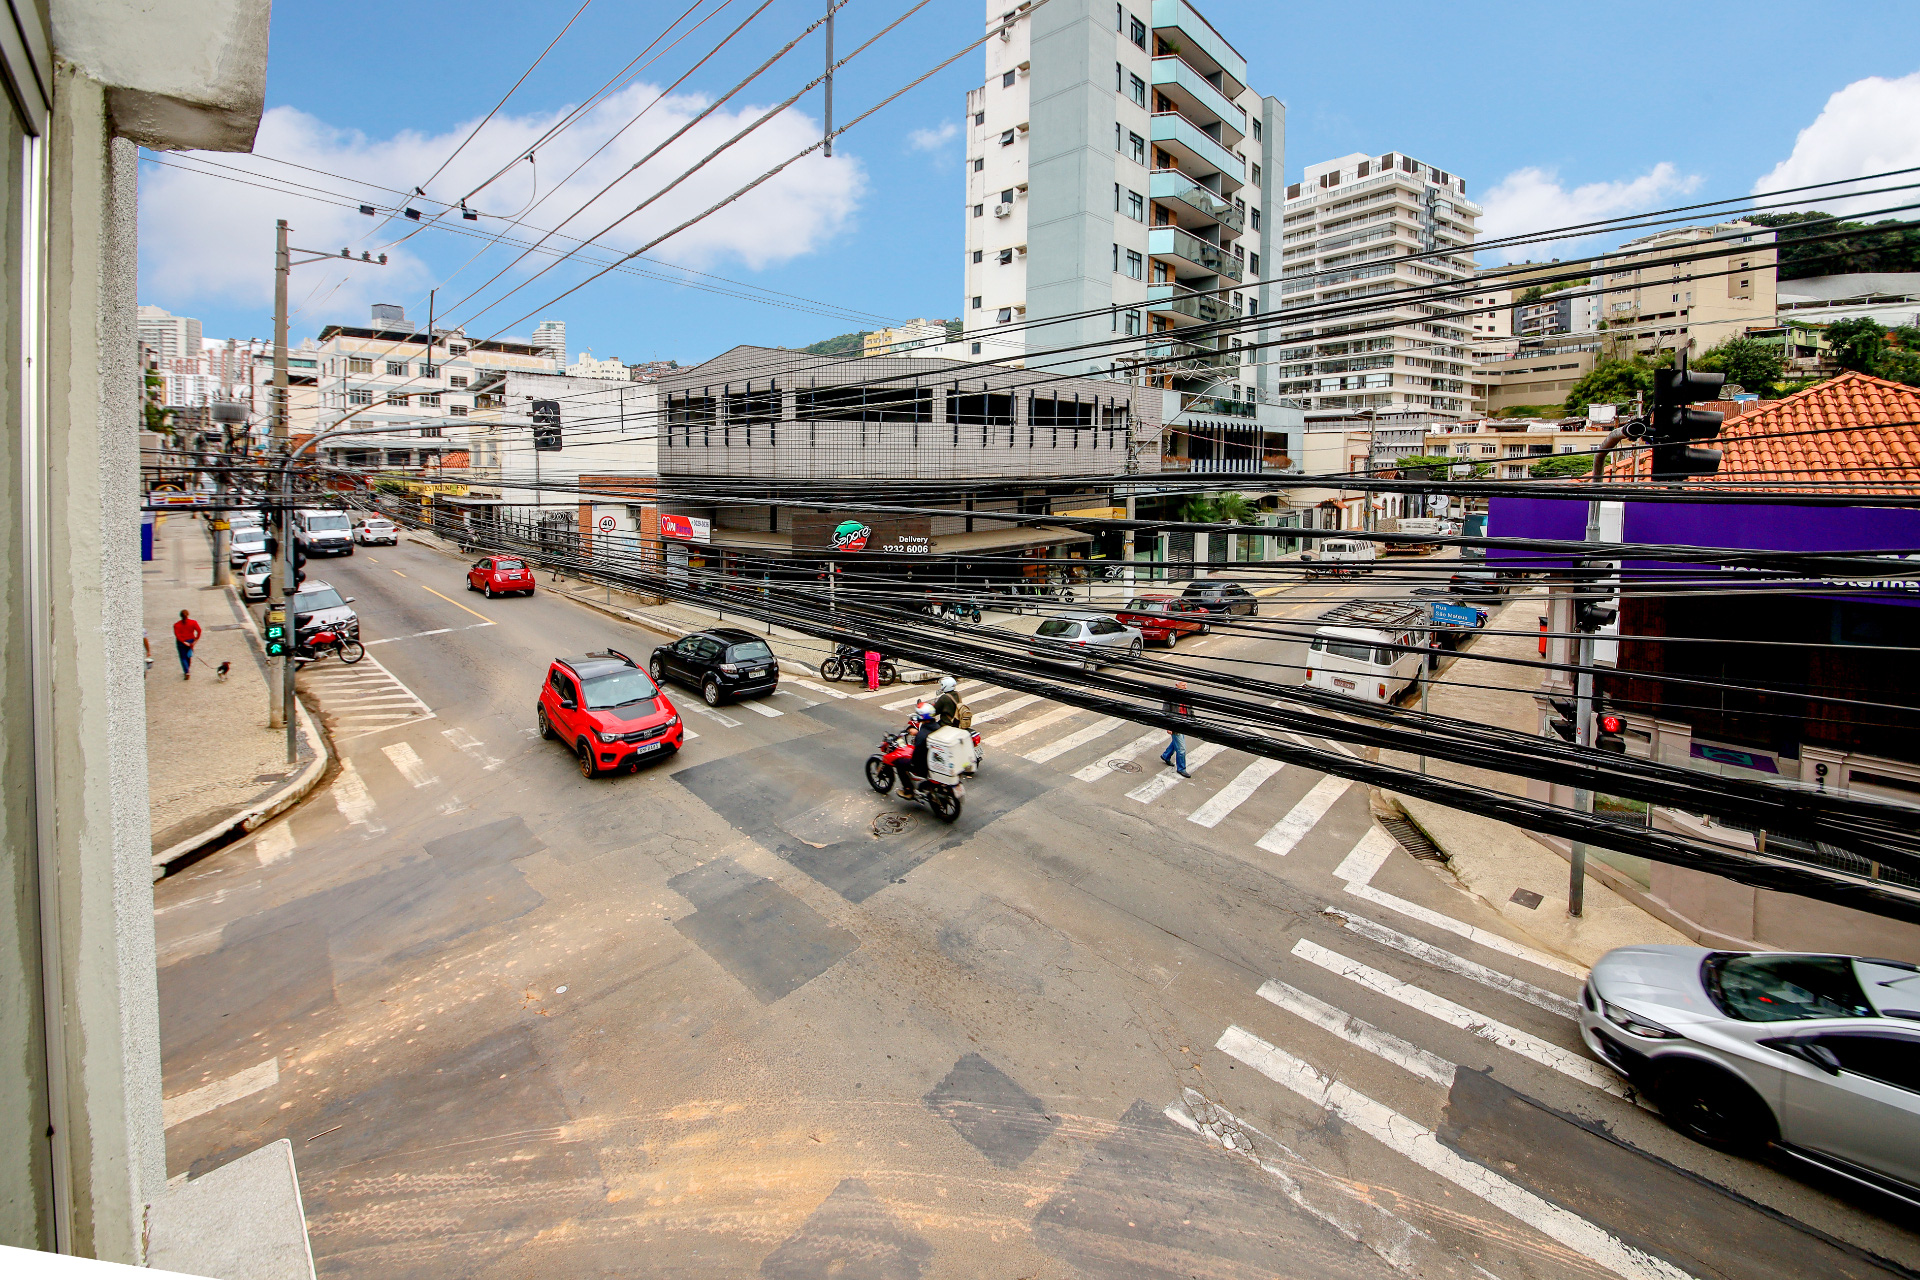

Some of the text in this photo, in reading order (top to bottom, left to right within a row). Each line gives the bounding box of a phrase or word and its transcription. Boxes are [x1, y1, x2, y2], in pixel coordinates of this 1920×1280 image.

[602, 519, 613, 527] 40
[827, 526, 871, 548] Sapore
[899, 536, 928, 544] Delivery
[883, 545, 928, 553] 3232 6006
[269, 627, 282, 637] 23
